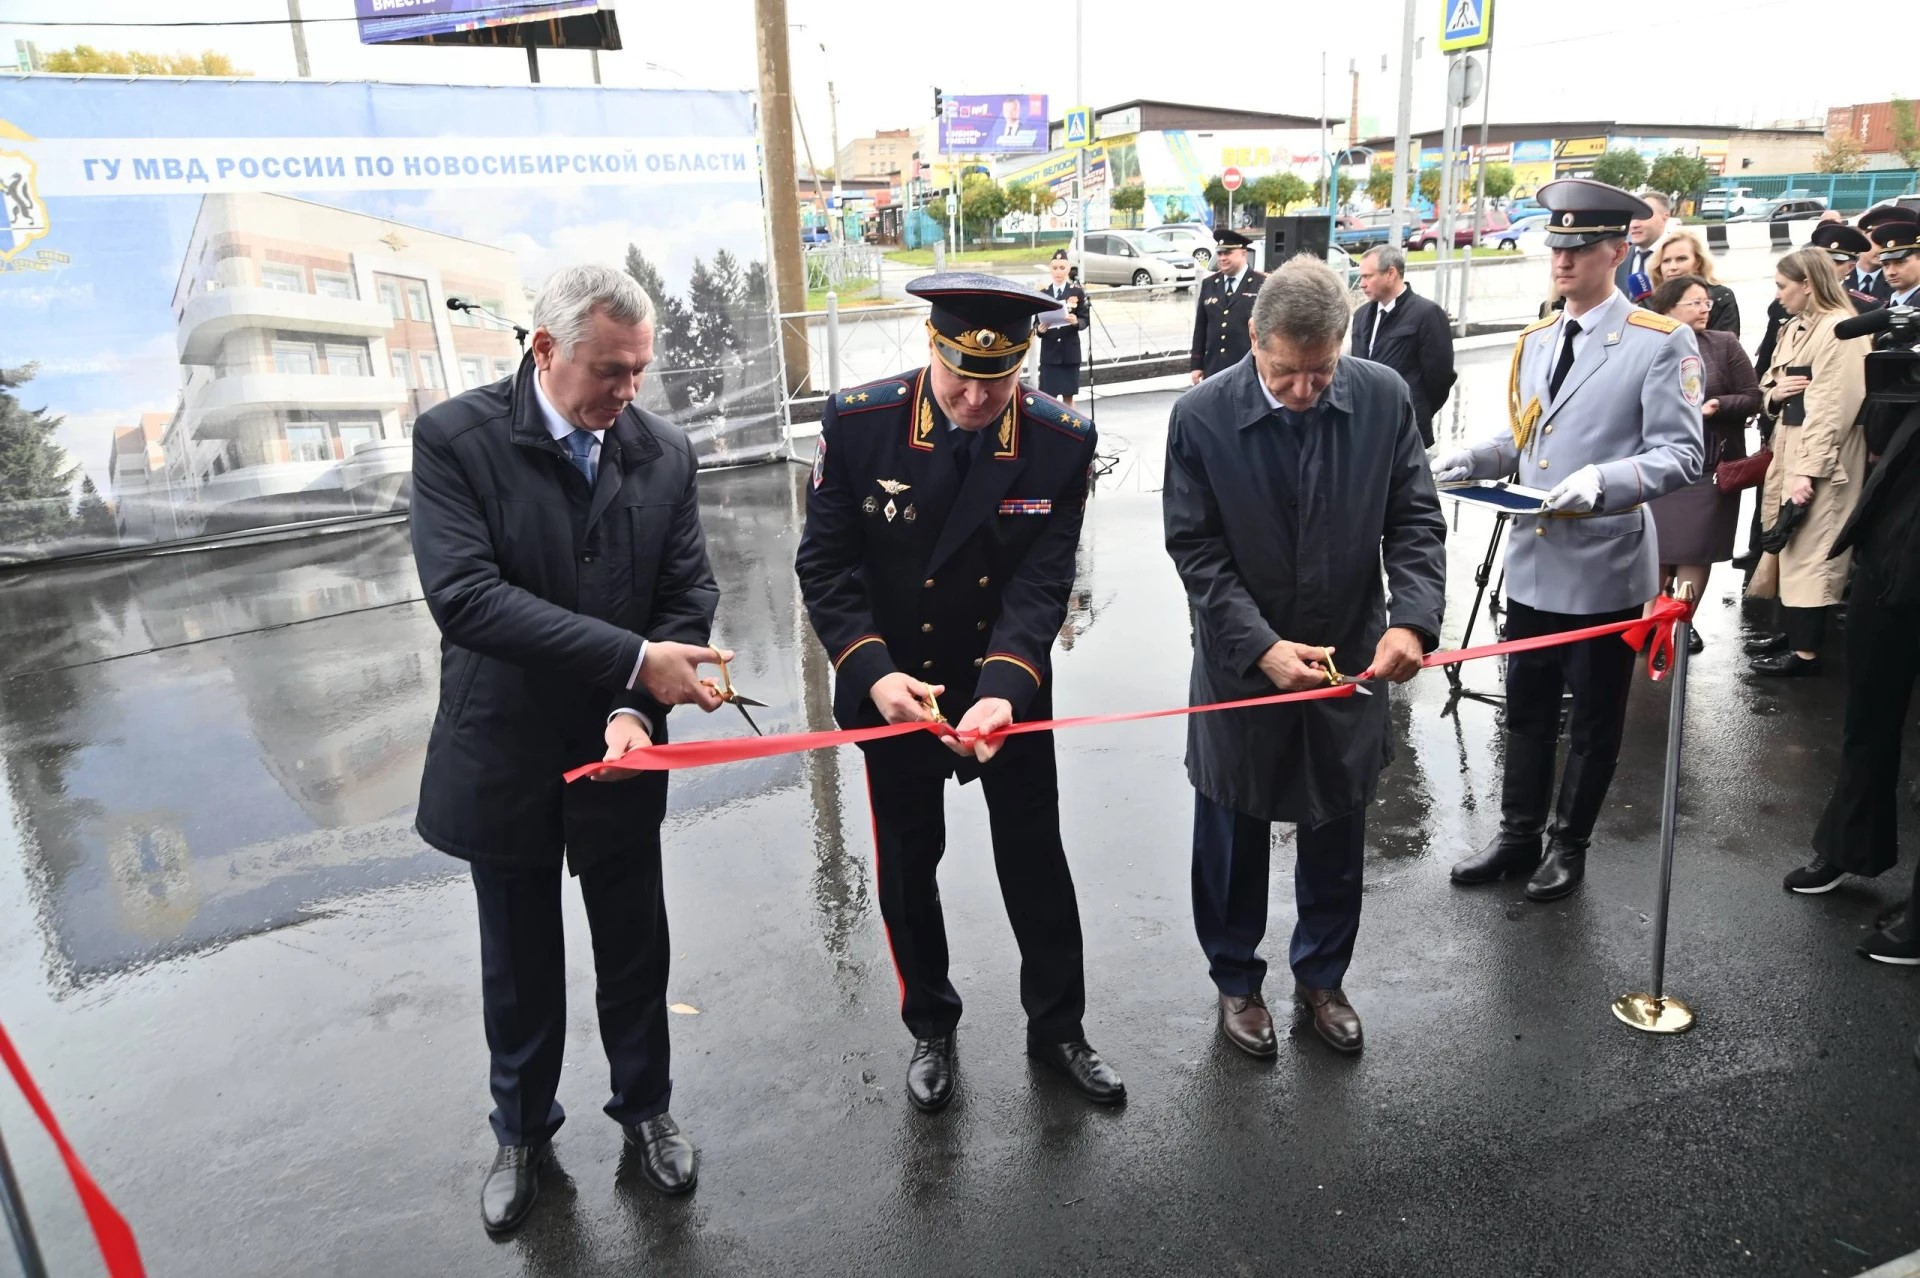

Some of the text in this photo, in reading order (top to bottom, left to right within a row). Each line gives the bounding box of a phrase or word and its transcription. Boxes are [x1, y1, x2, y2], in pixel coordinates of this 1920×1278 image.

[83, 149, 746, 183] ГУ МВД РОССИИ ПО НОВОСИБИРСКОЙ ОБЛАСТИ
